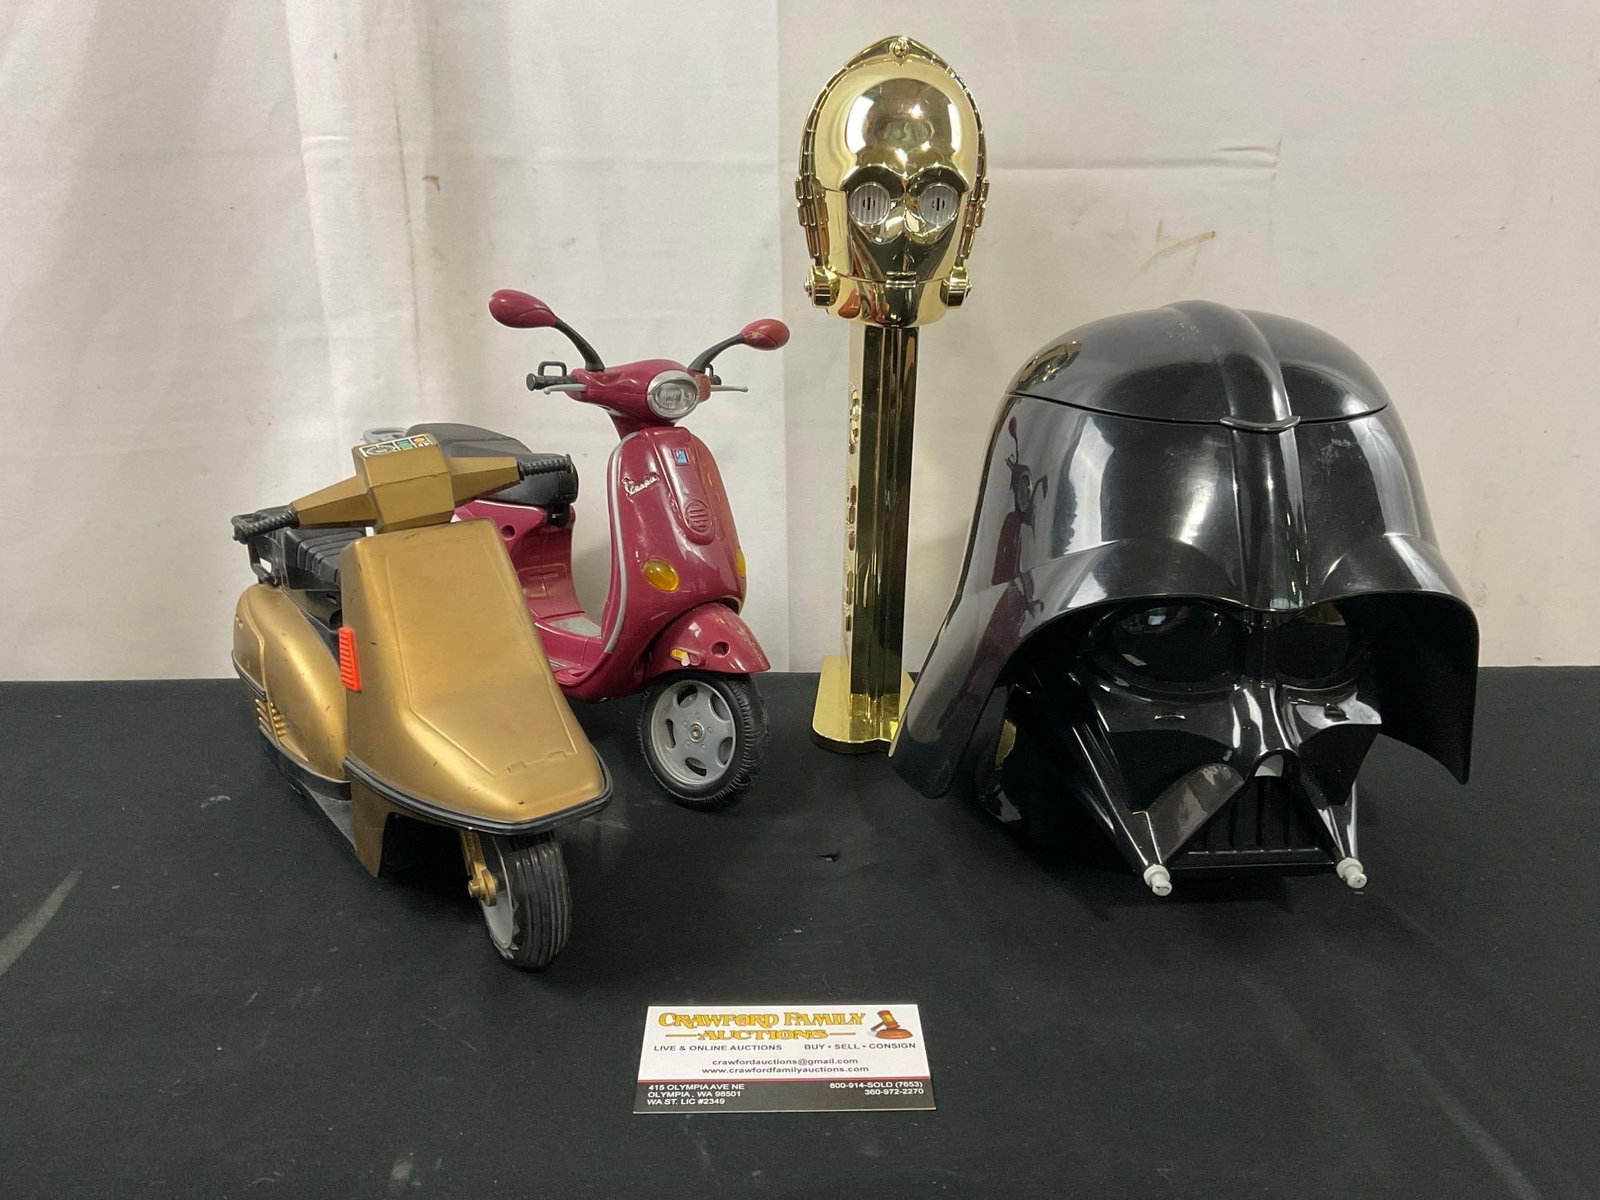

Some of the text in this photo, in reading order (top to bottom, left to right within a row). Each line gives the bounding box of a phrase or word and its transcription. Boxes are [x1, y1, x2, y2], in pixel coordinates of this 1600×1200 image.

[658, 1012, 866, 1029] CRAWFORD FAMILY
[698, 1030, 829, 1040] AUCTIONS
[712, 1058, 858, 1066] crawfordauctions@gmail.com
[702, 1066, 869, 1074] www.crawfordfamilyauctions.com
[829, 1081, 893, 1089] 800-914-SOLD
[864, 1088, 924, 1096] 360-972-2270
[698, 1097, 726, 1105] #2349
